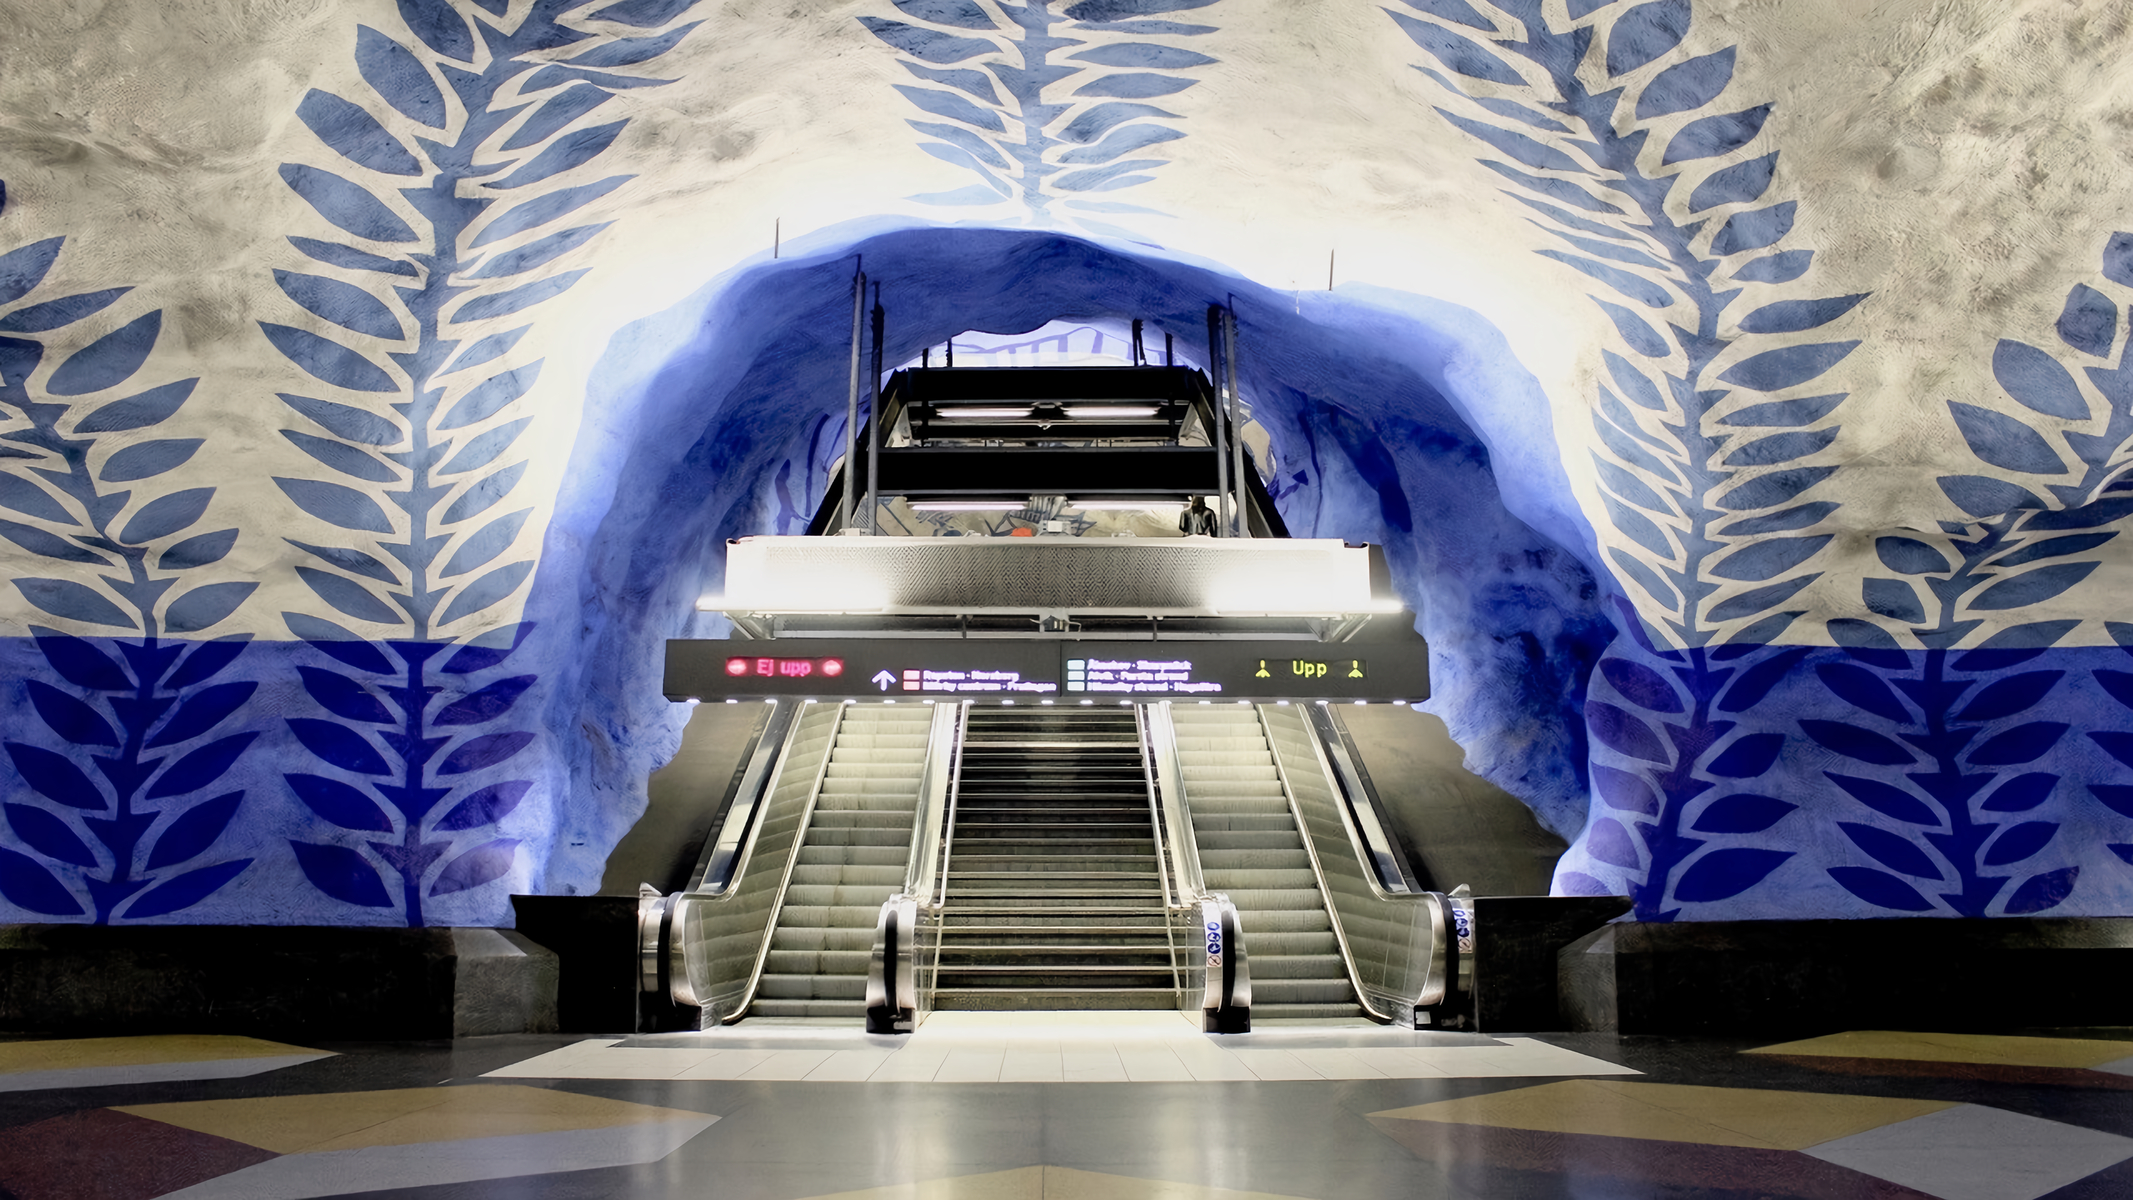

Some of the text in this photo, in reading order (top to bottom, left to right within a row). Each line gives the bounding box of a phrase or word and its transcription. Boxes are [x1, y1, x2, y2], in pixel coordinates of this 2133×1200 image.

[757, 659, 811, 677] Ej upp
[1292, 660, 1327, 678] Upp
